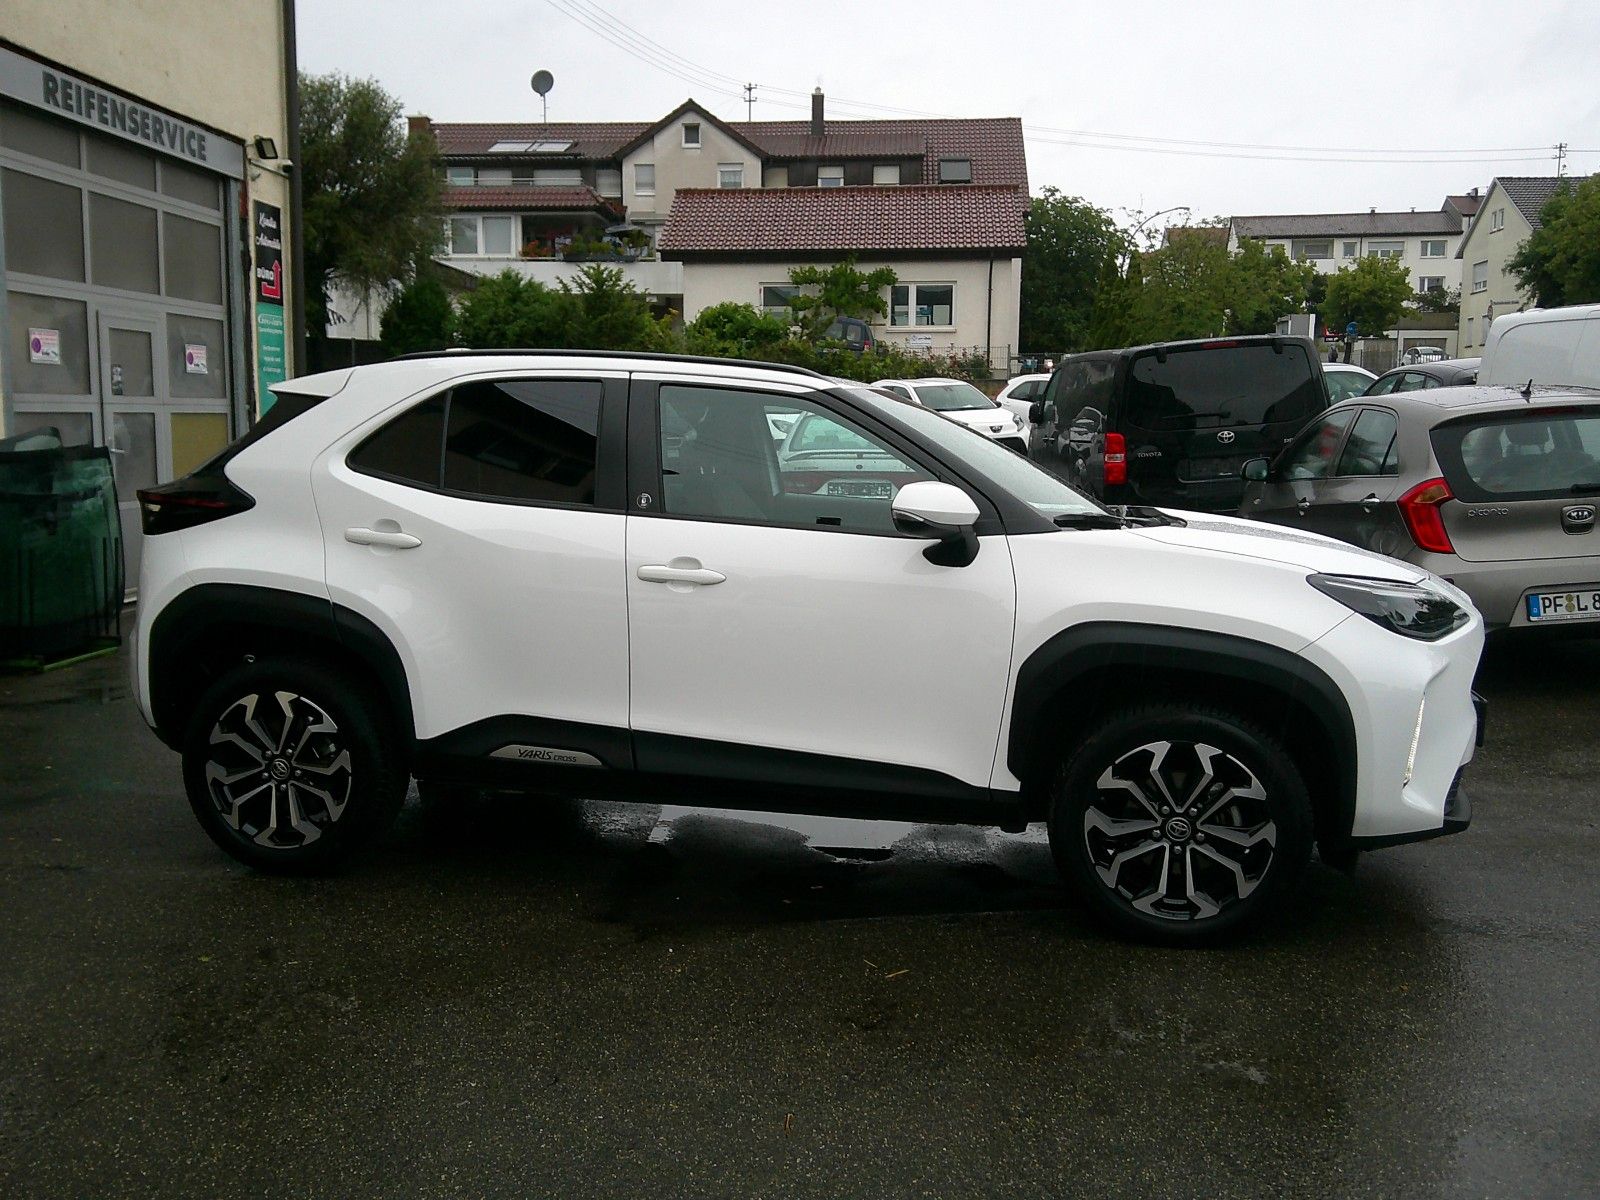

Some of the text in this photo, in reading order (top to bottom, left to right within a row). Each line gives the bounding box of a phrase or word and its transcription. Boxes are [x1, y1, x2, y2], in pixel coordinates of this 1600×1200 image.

[41, 70, 207, 162] REIFENSERVICE
[1541, 595, 1564, 614] PF
[517, 747, 577, 763] YARIS CROSS
